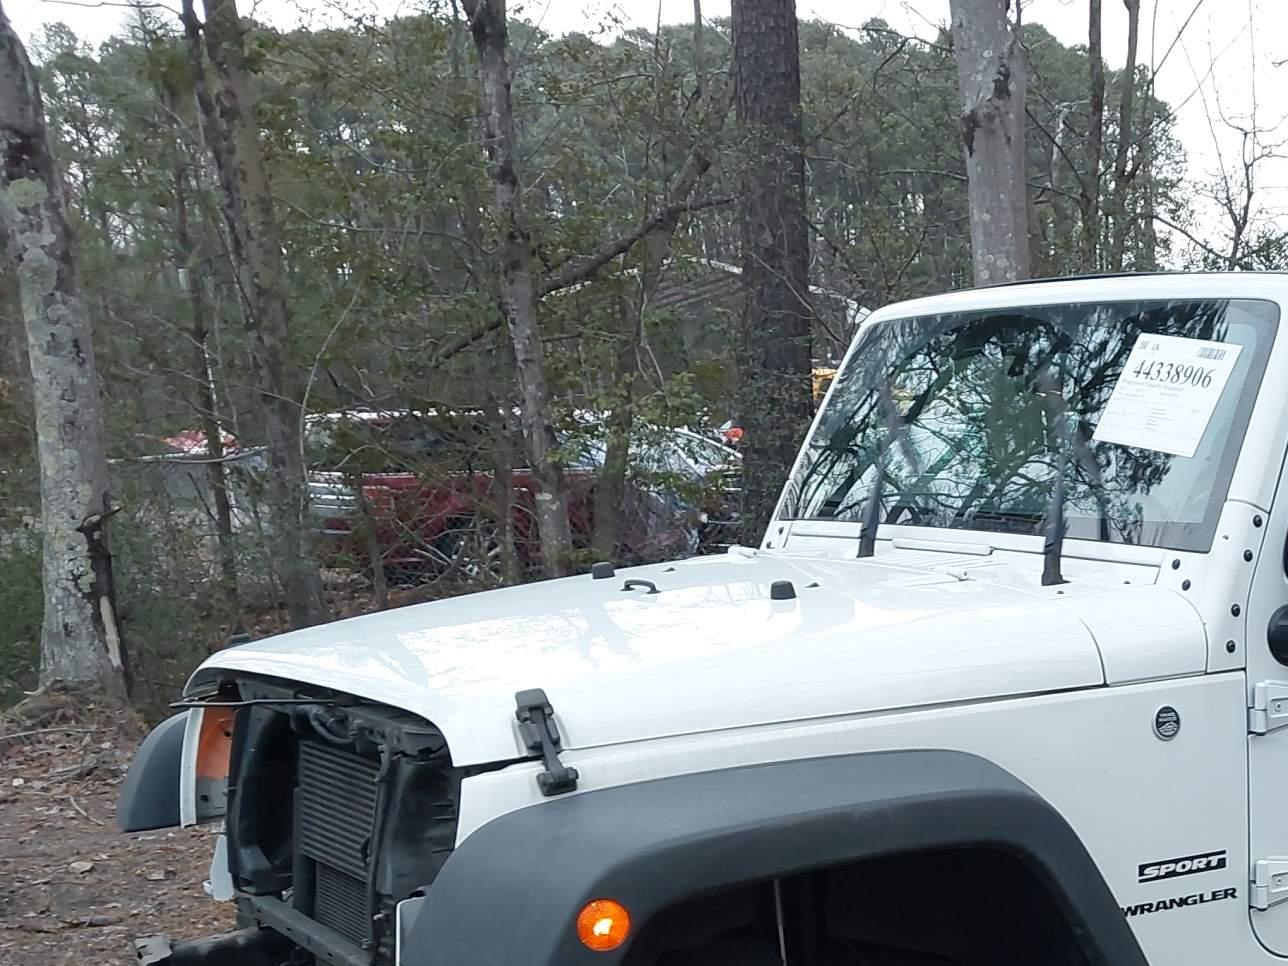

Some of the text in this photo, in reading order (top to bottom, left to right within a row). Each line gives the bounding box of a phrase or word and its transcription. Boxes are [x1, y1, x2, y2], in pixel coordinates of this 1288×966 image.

[1132, 359, 1217, 389] 44338906
[1142, 855, 1221, 879] SPORT
[1119, 886, 1239, 918] WRANGLER
